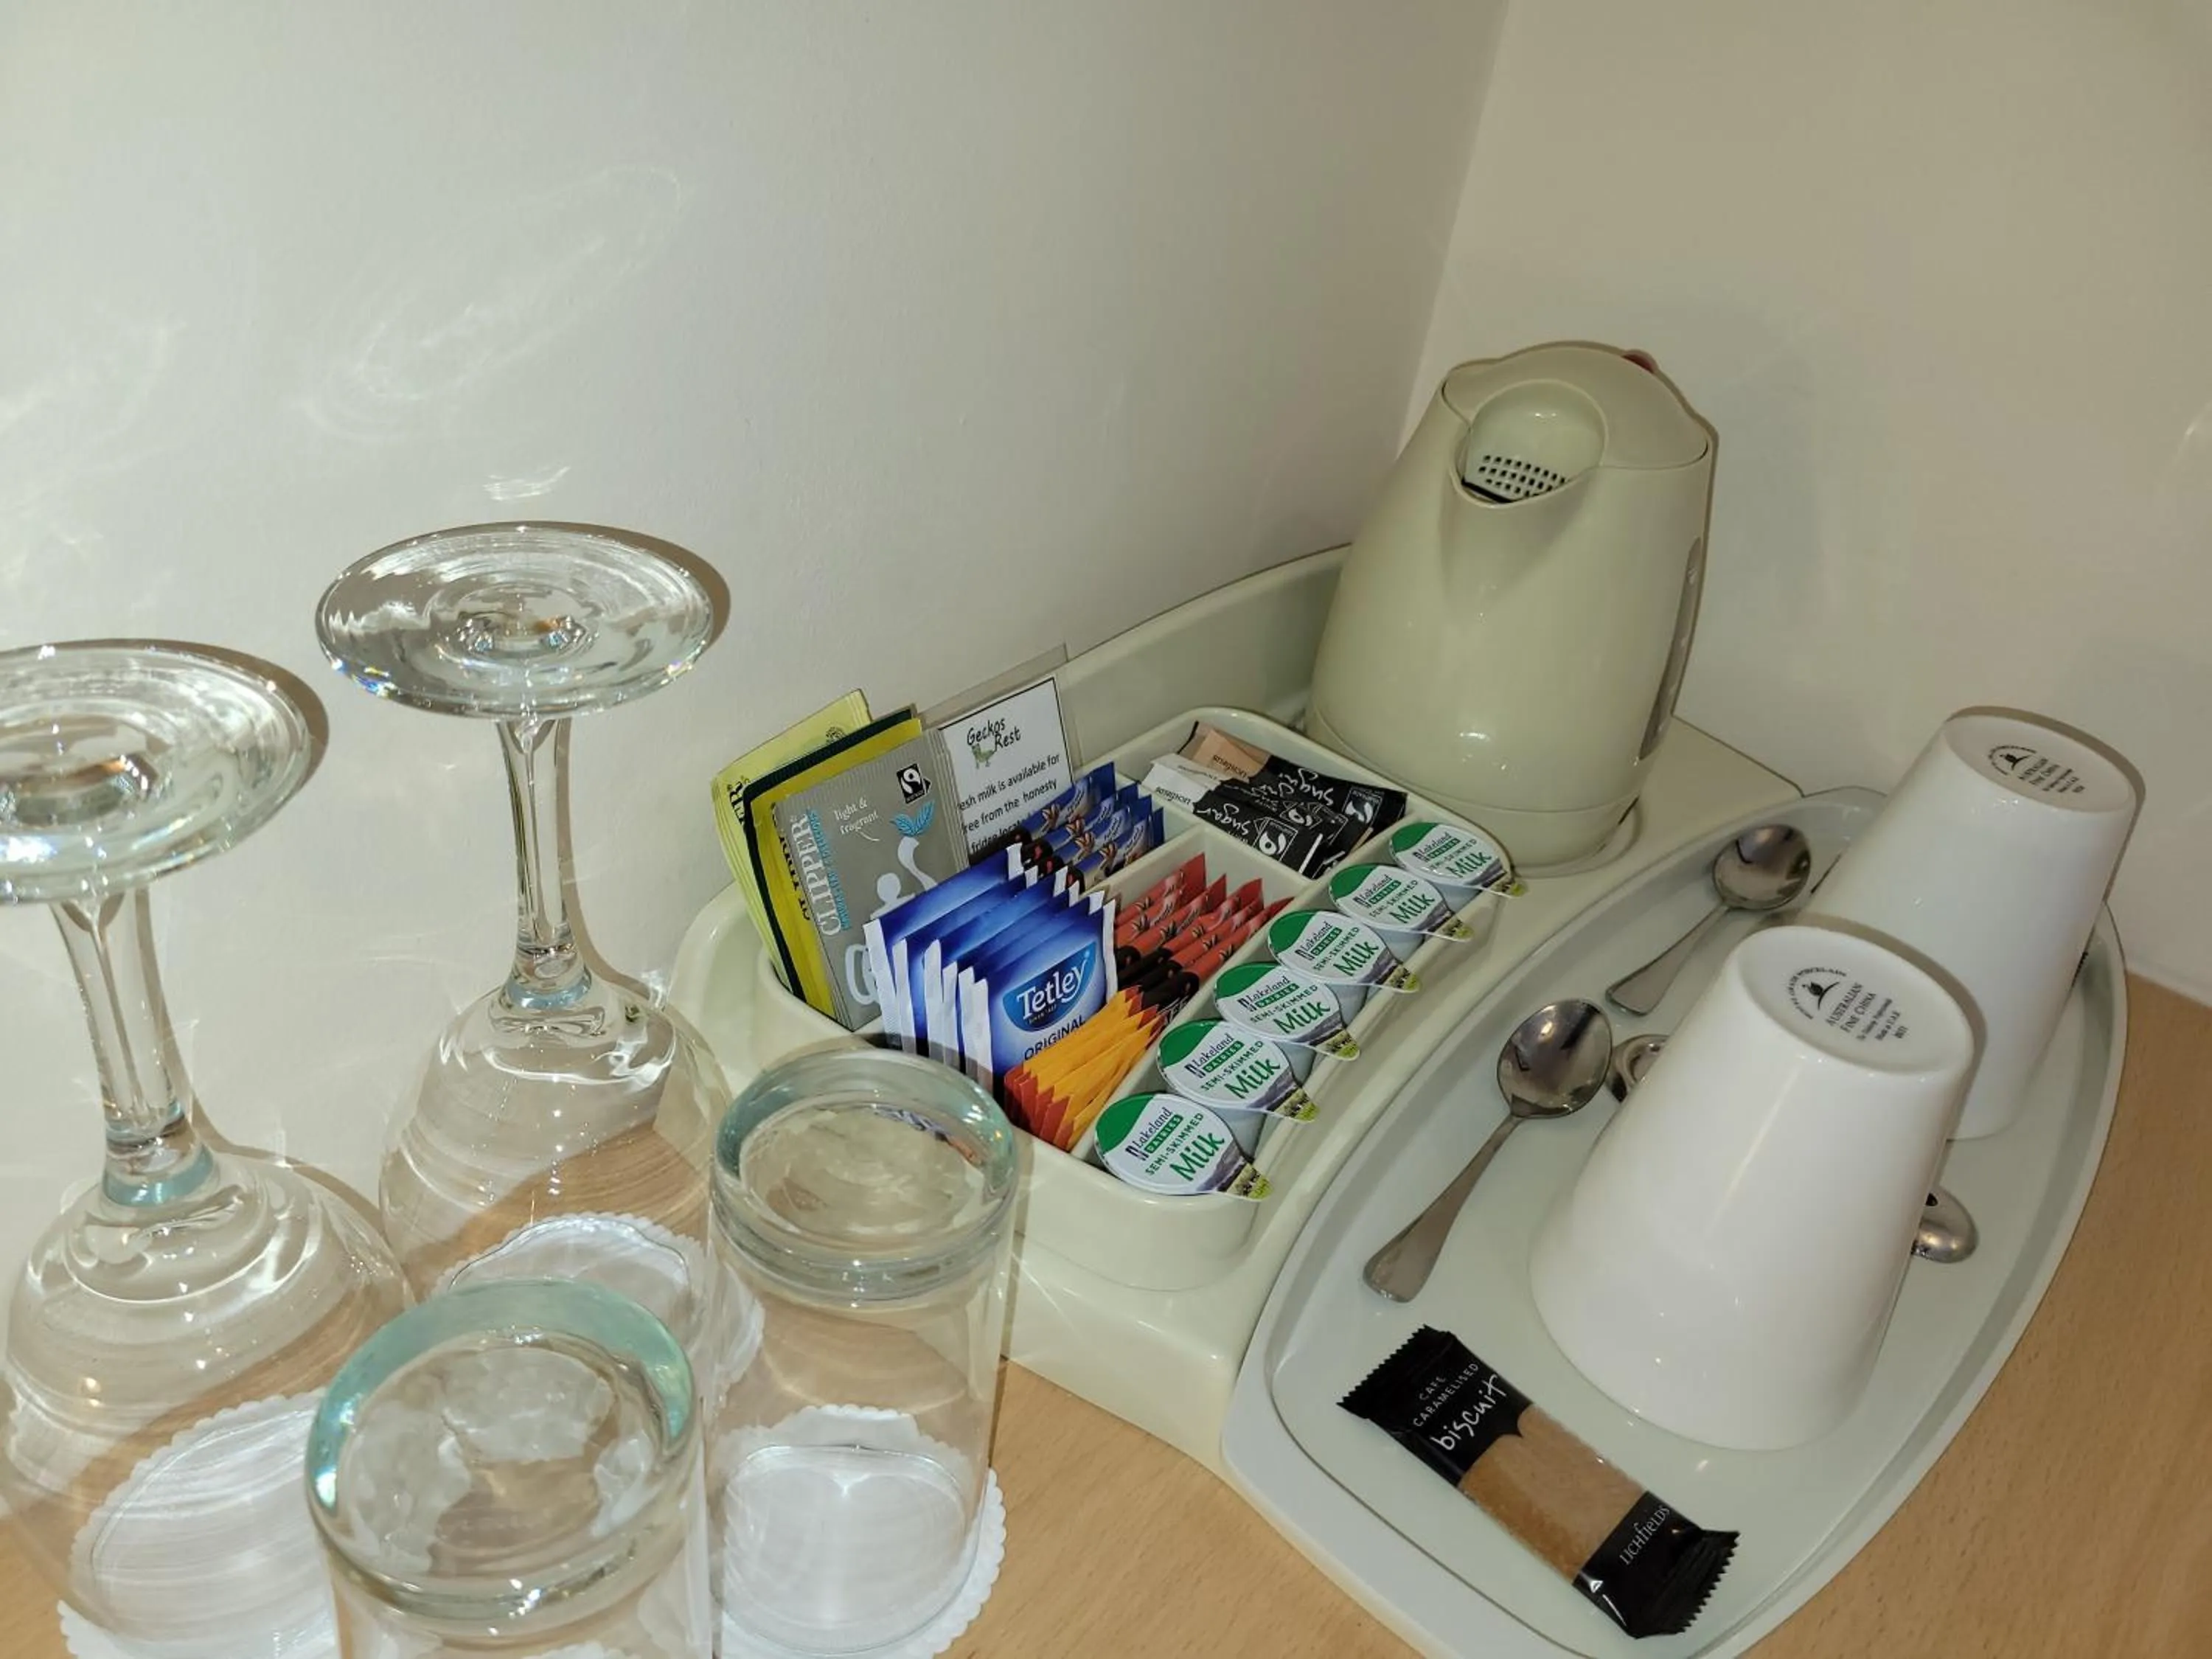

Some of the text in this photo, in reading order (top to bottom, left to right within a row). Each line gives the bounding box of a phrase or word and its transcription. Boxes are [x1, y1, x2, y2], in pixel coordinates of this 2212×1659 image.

[967, 717, 1006, 746] Geckos
[995, 726, 1021, 751] Rest
[959, 753, 1060, 811] esh milk is available for
[981, 807, 1004, 825] from
[1004, 797, 1020, 812] the
[1022, 779, 1057, 804] honesty
[833, 802, 858, 823] light
[791, 813, 841, 936] CLIPPER
[1446, 851, 1492, 878] Milk
[1389, 893, 1435, 924] Milk
[1333, 941, 1379, 976] Milk
[1017, 955, 1088, 1020] Tetley
[1023, 1014, 1086, 1061] ORIGINAL
[1273, 1001, 1331, 1034] Milk
[1192, 1033, 1235, 1068] Lakeland
[1200, 1040, 1265, 1091] SEMI-SKIMMED
[1224, 1058, 1281, 1099] Milk
[1133, 1107, 1174, 1149] Lakeland
[1145, 1112, 1205, 1175] SEMI-SKIMMED
[1169, 1132, 1225, 1182] Milk
[1413, 1362, 1479, 1427] CARAMELISED
[1430, 1373, 1507, 1451] biscuit
